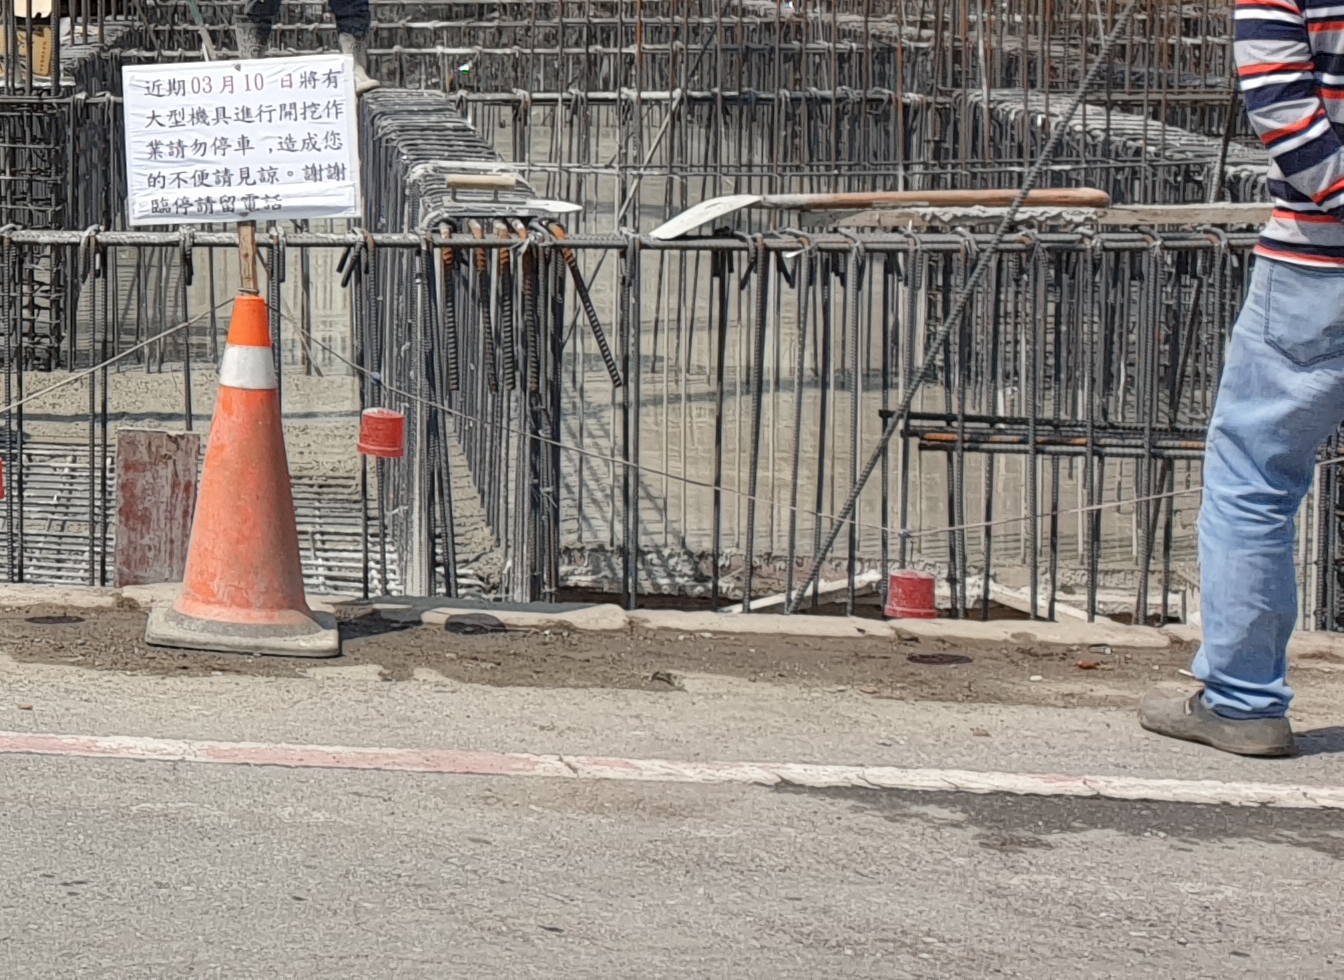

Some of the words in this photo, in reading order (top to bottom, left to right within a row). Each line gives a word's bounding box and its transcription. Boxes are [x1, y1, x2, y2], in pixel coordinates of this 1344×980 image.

[144, 99, 344, 128] 大型機具進行開挖作
